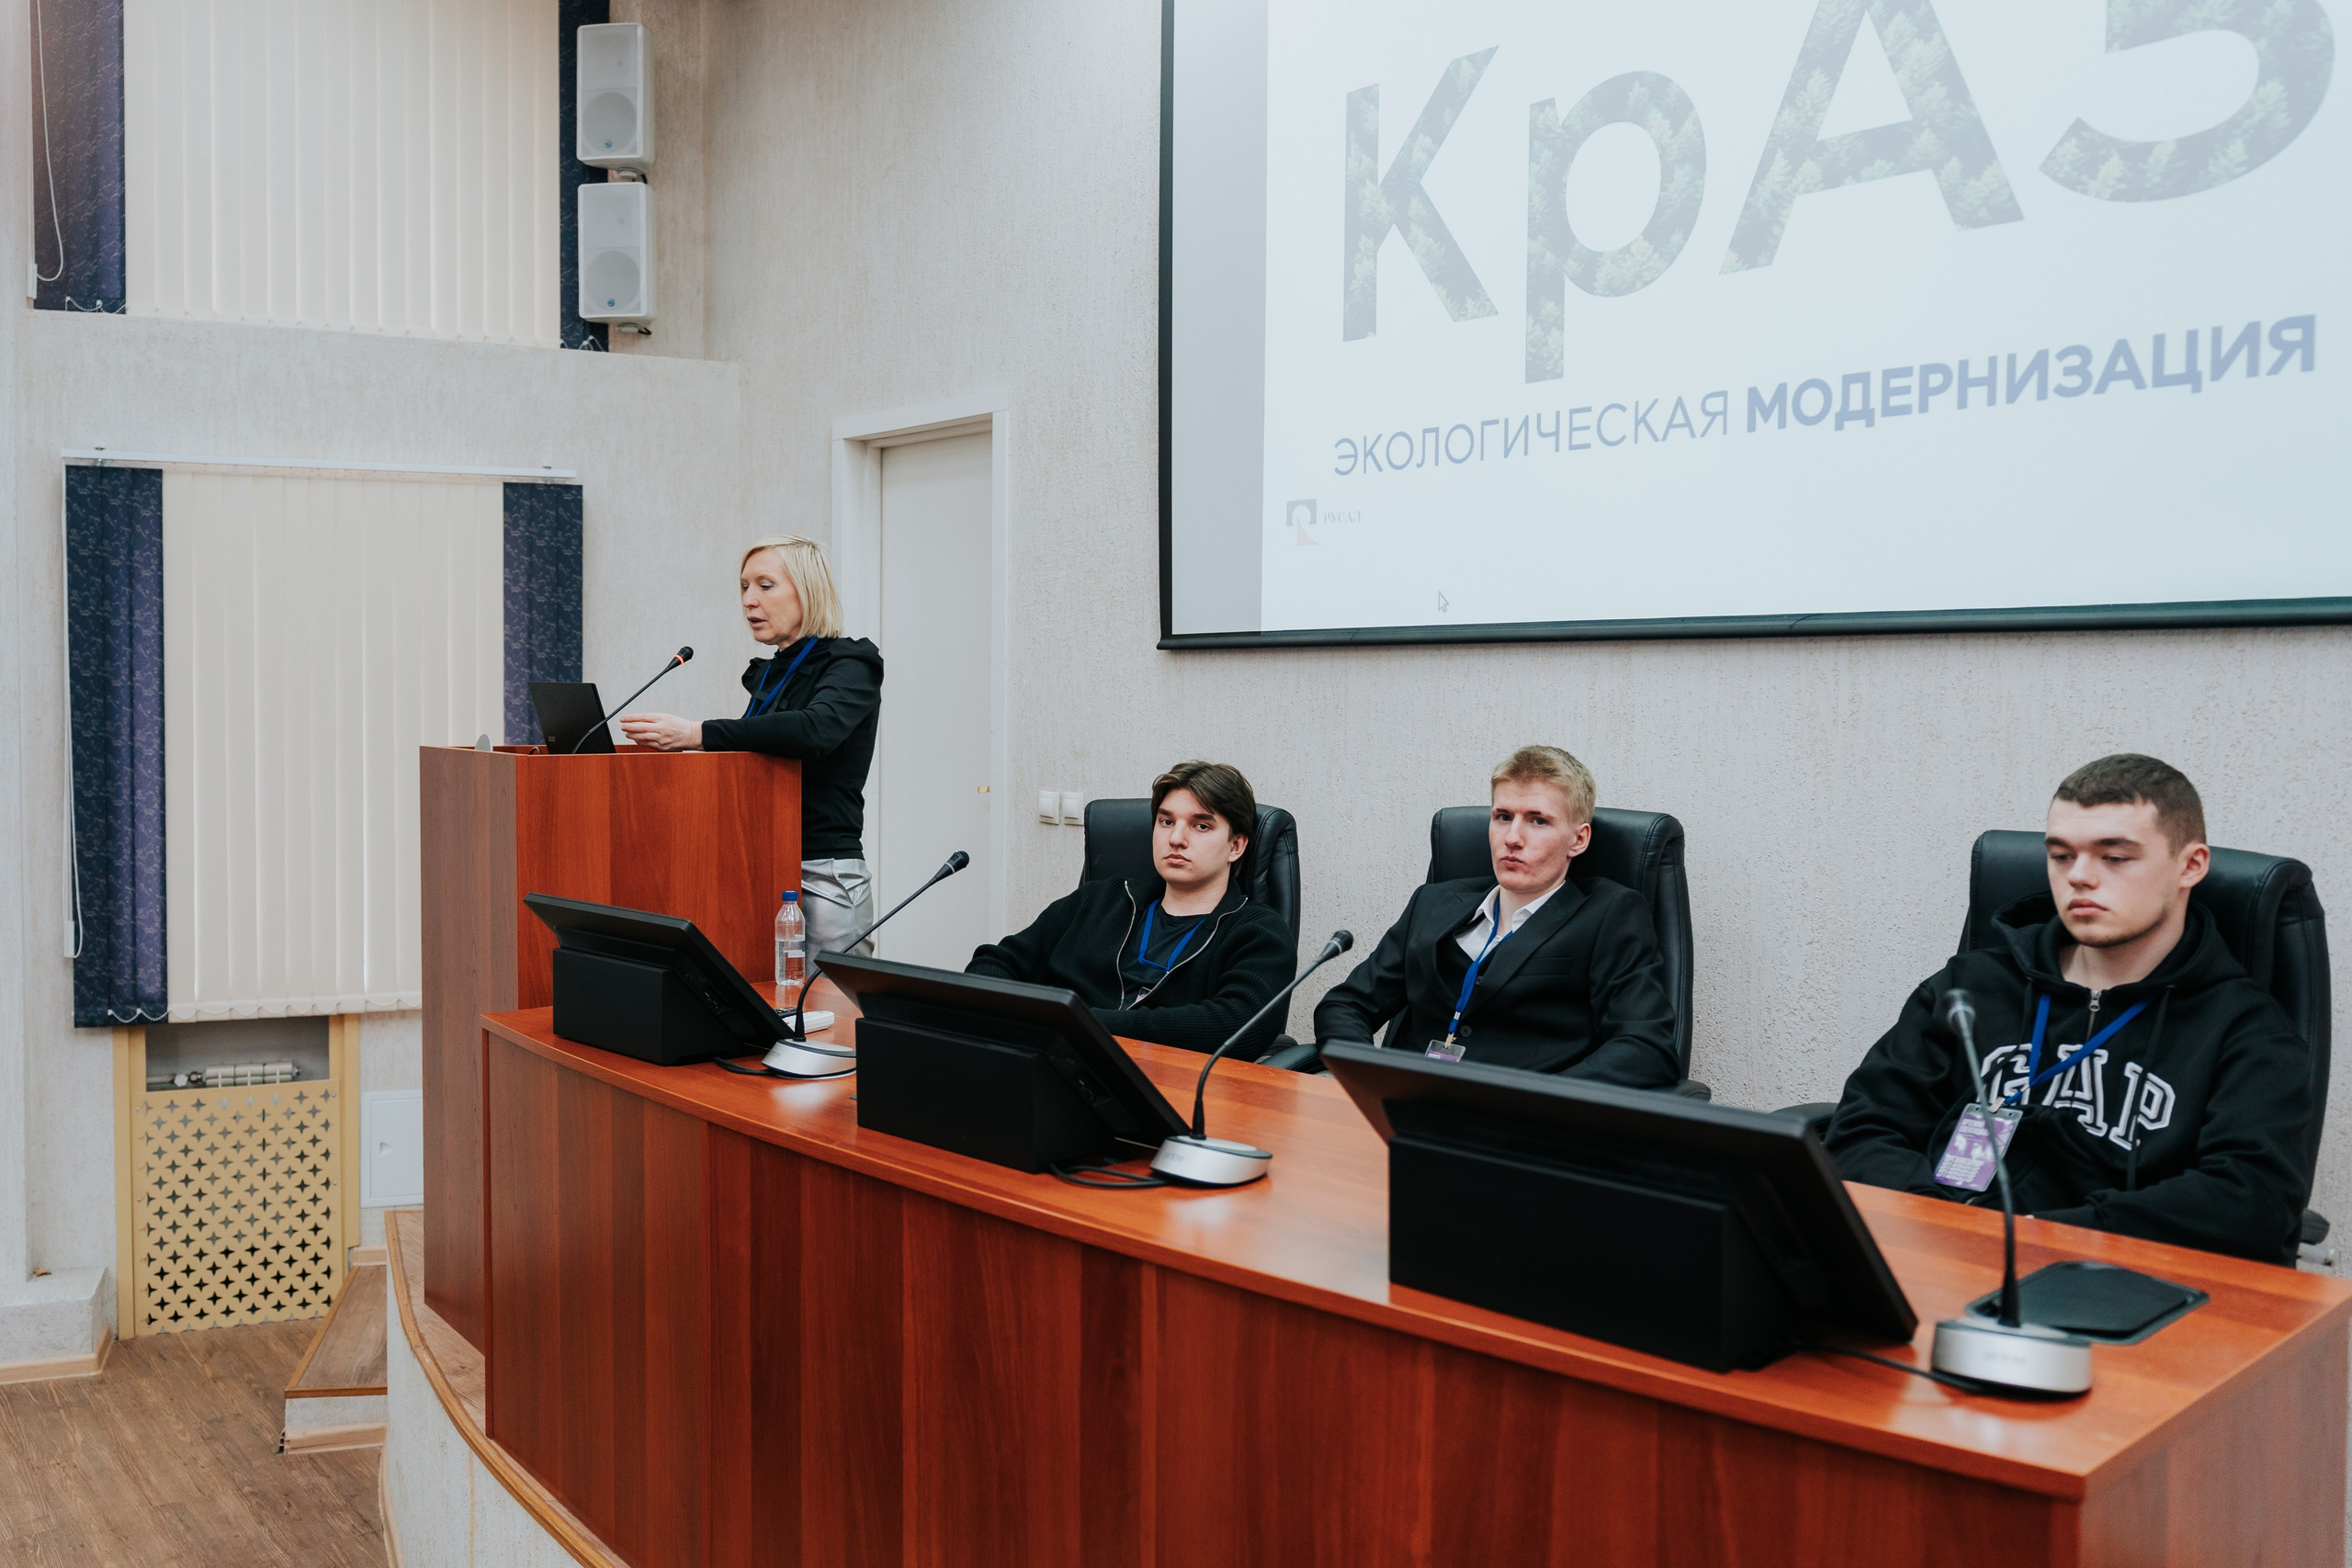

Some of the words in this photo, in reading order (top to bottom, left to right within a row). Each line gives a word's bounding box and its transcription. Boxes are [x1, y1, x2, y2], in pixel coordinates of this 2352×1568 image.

[1334, 389, 1728, 476] ЭКОЛОГИЧЕСКАЯ
[1746, 313, 2316, 433] МОДЕРНИЗАЦИЯ
[1975, 1043, 2176, 1150] GAP
